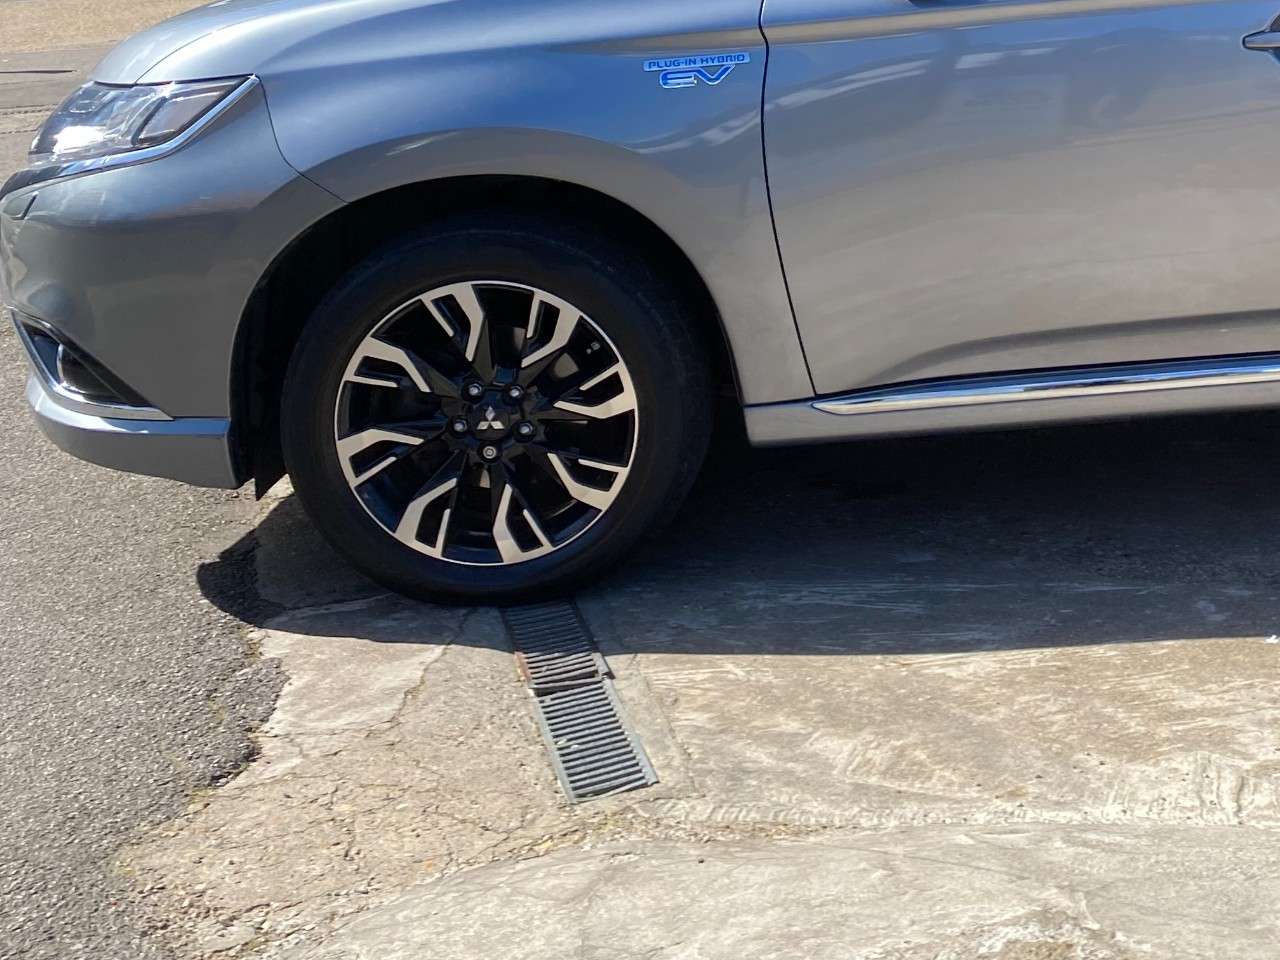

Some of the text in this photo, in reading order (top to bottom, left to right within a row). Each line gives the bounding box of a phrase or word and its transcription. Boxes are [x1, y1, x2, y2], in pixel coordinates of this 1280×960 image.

[648, 53, 745, 69] PLUG-IN HYBRID
[660, 64, 735, 89] EV
